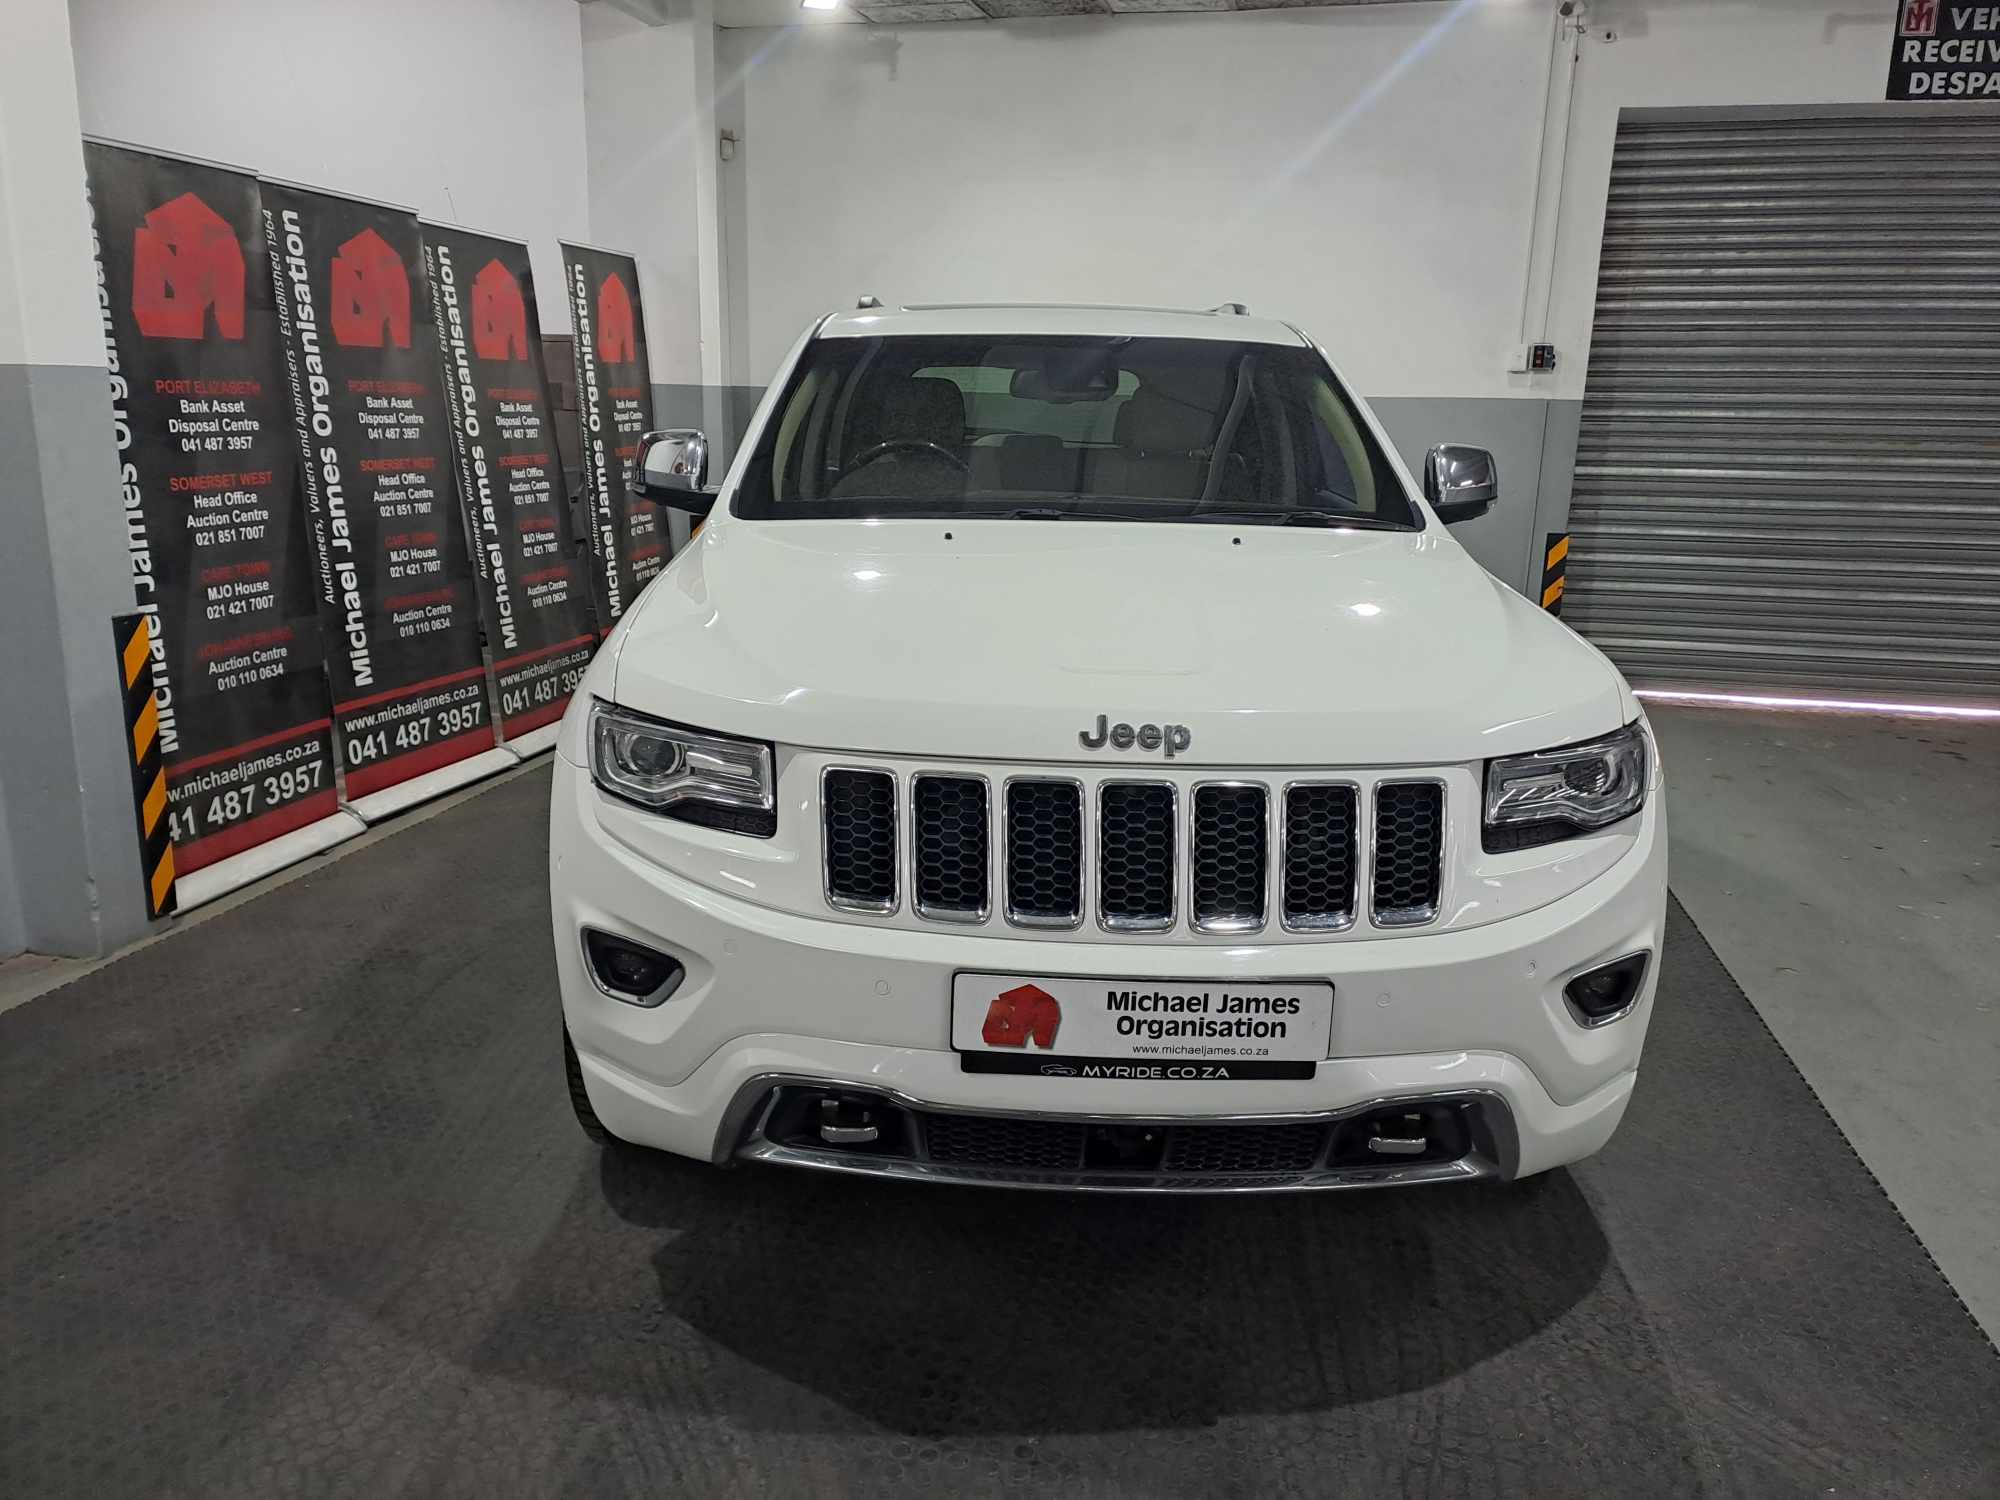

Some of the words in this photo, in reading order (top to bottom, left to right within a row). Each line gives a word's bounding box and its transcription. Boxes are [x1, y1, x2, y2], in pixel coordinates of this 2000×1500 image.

[1908, 71, 2000, 95] DESPA
[262, 209, 277, 247] 1964
[270, 247, 293, 338] Established
[282, 209, 334, 437] Organisation
[430, 281, 449, 353] Established
[437, 245, 479, 437] Organisation
[574, 263, 601, 432] Organisation
[155, 380, 193, 394] PORT
[286, 349, 307, 428] Appraisers
[444, 364, 462, 428] Appraisers
[180, 399, 210, 413] Bank
[212, 400, 246, 413] Asset
[366, 396, 389, 408] Bank
[390, 397, 414, 409] Asset
[168, 418, 220, 435] Disposal
[222, 418, 260, 431] Centre
[358, 412, 397, 426] Disposal
[398, 412, 424, 424] Centre
[181, 438, 201, 452] 041
[204, 437, 223, 451] 487
[227, 436, 253, 450] 3957
[297, 429, 311, 457] and
[368, 428, 383, 440] 041
[385, 428, 400, 439] 487
[402, 428, 420, 439] 3957
[454, 430, 467, 456] and
[170, 474, 236, 491] SOMERSET
[240, 471, 273, 486] WEST
[303, 459, 320, 514] Valuers
[377, 474, 400, 486] Head
[401, 473, 426, 485] Office
[458, 457, 475, 502] Valuers
[471, 445, 497, 536] James
[593, 439, 611, 518] James
[193, 493, 222, 508] Head
[224, 491, 258, 506] Office
[320, 447, 352, 553] James
[373, 490, 407, 502] Auction
[408, 488, 434, 500] Centre
[187, 512, 230, 528] Auction
[232, 509, 269, 523] Centre
[380, 505, 395, 517] 021
[397, 503, 412, 516] 851
[413, 502, 432, 514] 7007
[195, 531, 215, 546] 021
[218, 529, 237, 543] 851
[239, 525, 265, 540] 7007
[473, 506, 488, 579] Auctioneers,
[314, 519, 336, 604] Auctioneers,
[389, 566, 404, 578] 021
[406, 563, 421, 575] 421
[423, 560, 441, 573] 7007
[390, 550, 409, 563] MJO
[410, 548, 437, 560] House
[600, 525, 622, 617] Michael
[207, 584, 232, 601] MJO
[234, 581, 269, 596] House
[486, 543, 517, 649] Michael
[206, 604, 225, 620] 021
[228, 600, 247, 615] 421
[249, 595, 274, 611] 7007
[393, 608, 425, 624] Auction
[426, 604, 452, 617] Centre
[335, 561, 374, 687] Michael
[416, 620, 430, 634] 110
[431, 617, 451, 631] 0634
[208, 655, 251, 675] Auction
[252, 647, 288, 663] Centre
[500, 650, 589, 687] www.michaeljames.co.za
[217, 675, 237, 691] 010
[239, 670, 257, 685] 110
[259, 662, 284, 680] 0634
[502, 687, 530, 715] 041
[534, 676, 558, 702] 487
[561, 667, 584, 693] 395
[344, 684, 479, 732] www.michaeljames.co.za
[348, 730, 388, 765] 041
[396, 717, 431, 748] 487
[437, 701, 481, 736] 3957
[1079, 713, 1191, 759] Jeep
[167, 740, 320, 803] w.michaeljames.co.za
[168, 805, 196, 841] 41
[207, 784, 256, 825] 487
[263, 760, 322, 805] 3957
[1106, 990, 1209, 1013] Michael
[1216, 993, 1301, 1015] James
[1116, 1015, 1287, 1039] Organisation
[1132, 1044, 1269, 1057] www.michaeljames.co.za
[1082, 1066, 1230, 1080] MYRIDE.CO.ZA
